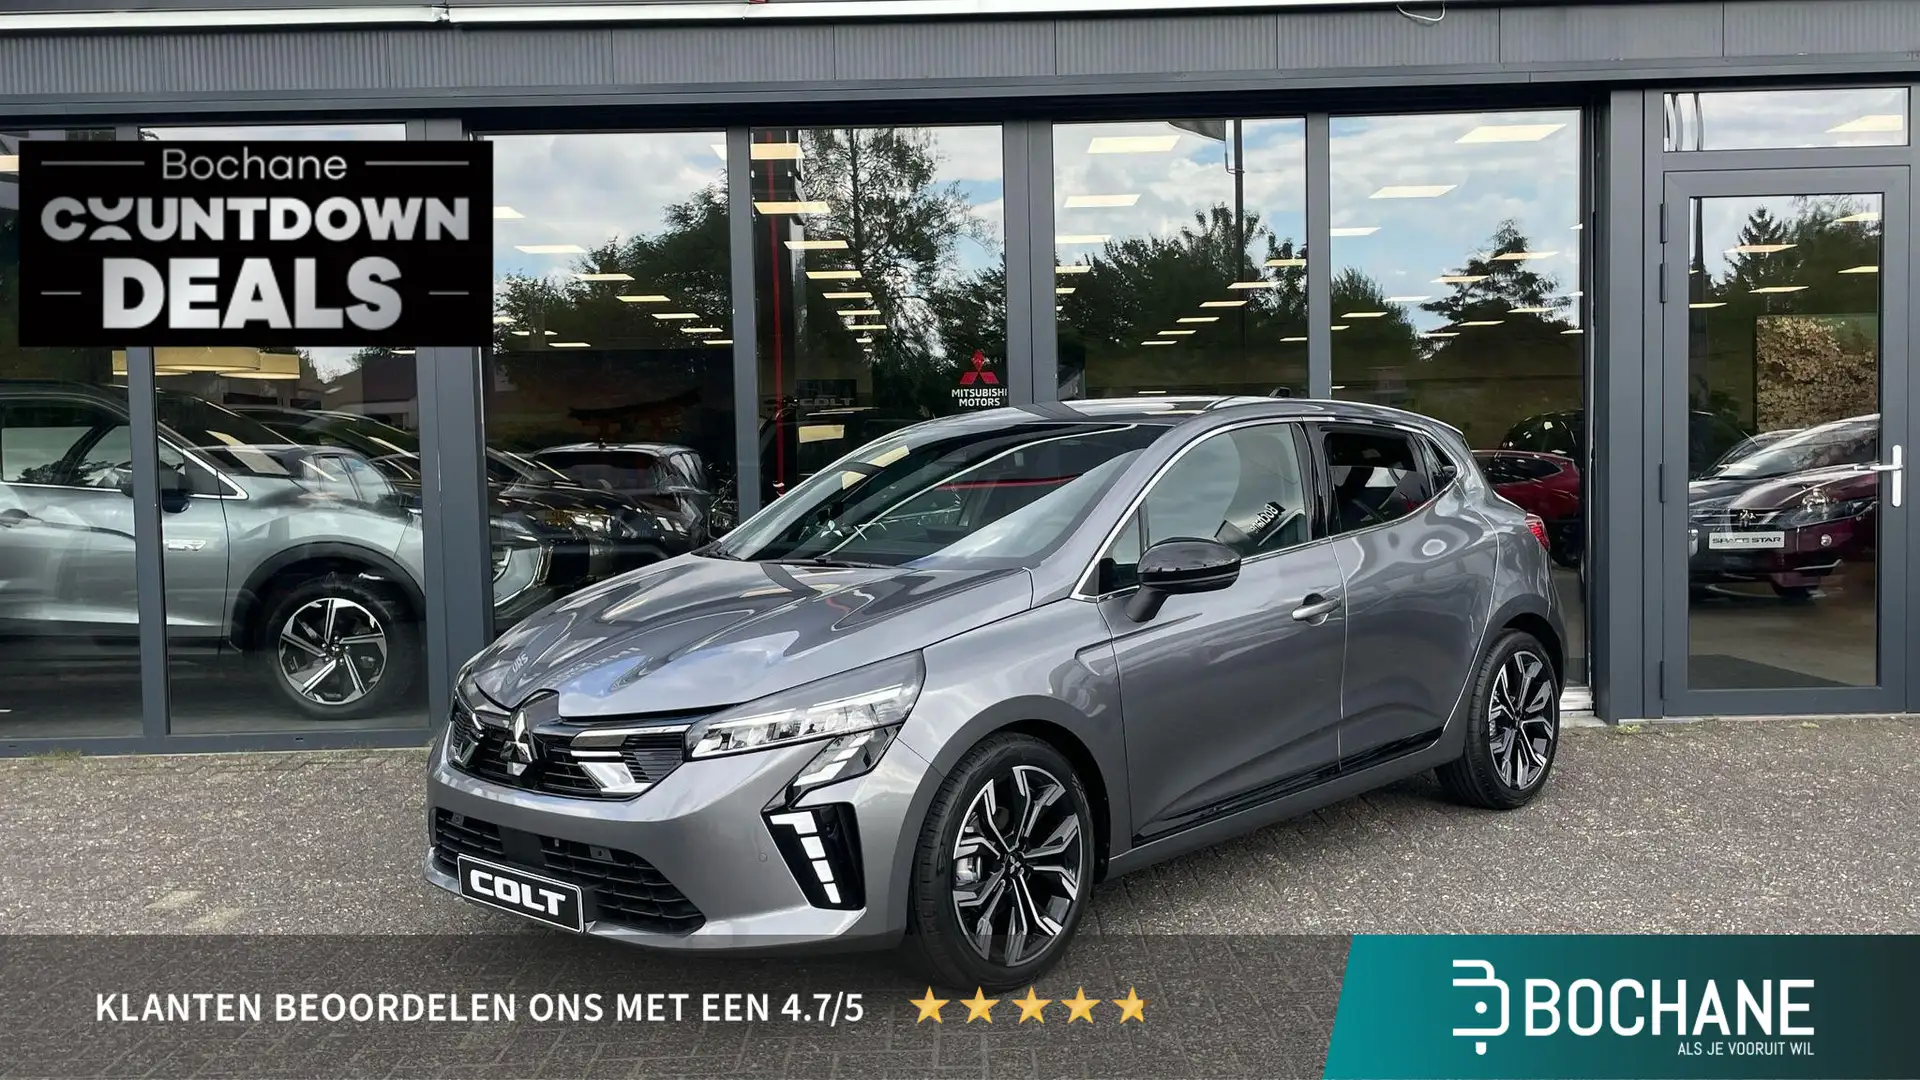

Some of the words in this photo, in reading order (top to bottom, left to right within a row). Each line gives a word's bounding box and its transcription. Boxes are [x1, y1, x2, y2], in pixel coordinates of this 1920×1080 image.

[951, 388, 1008, 398] MITSUBISHI
[959, 398, 1001, 407] MOTORS
[470, 869, 566, 916] COLT
